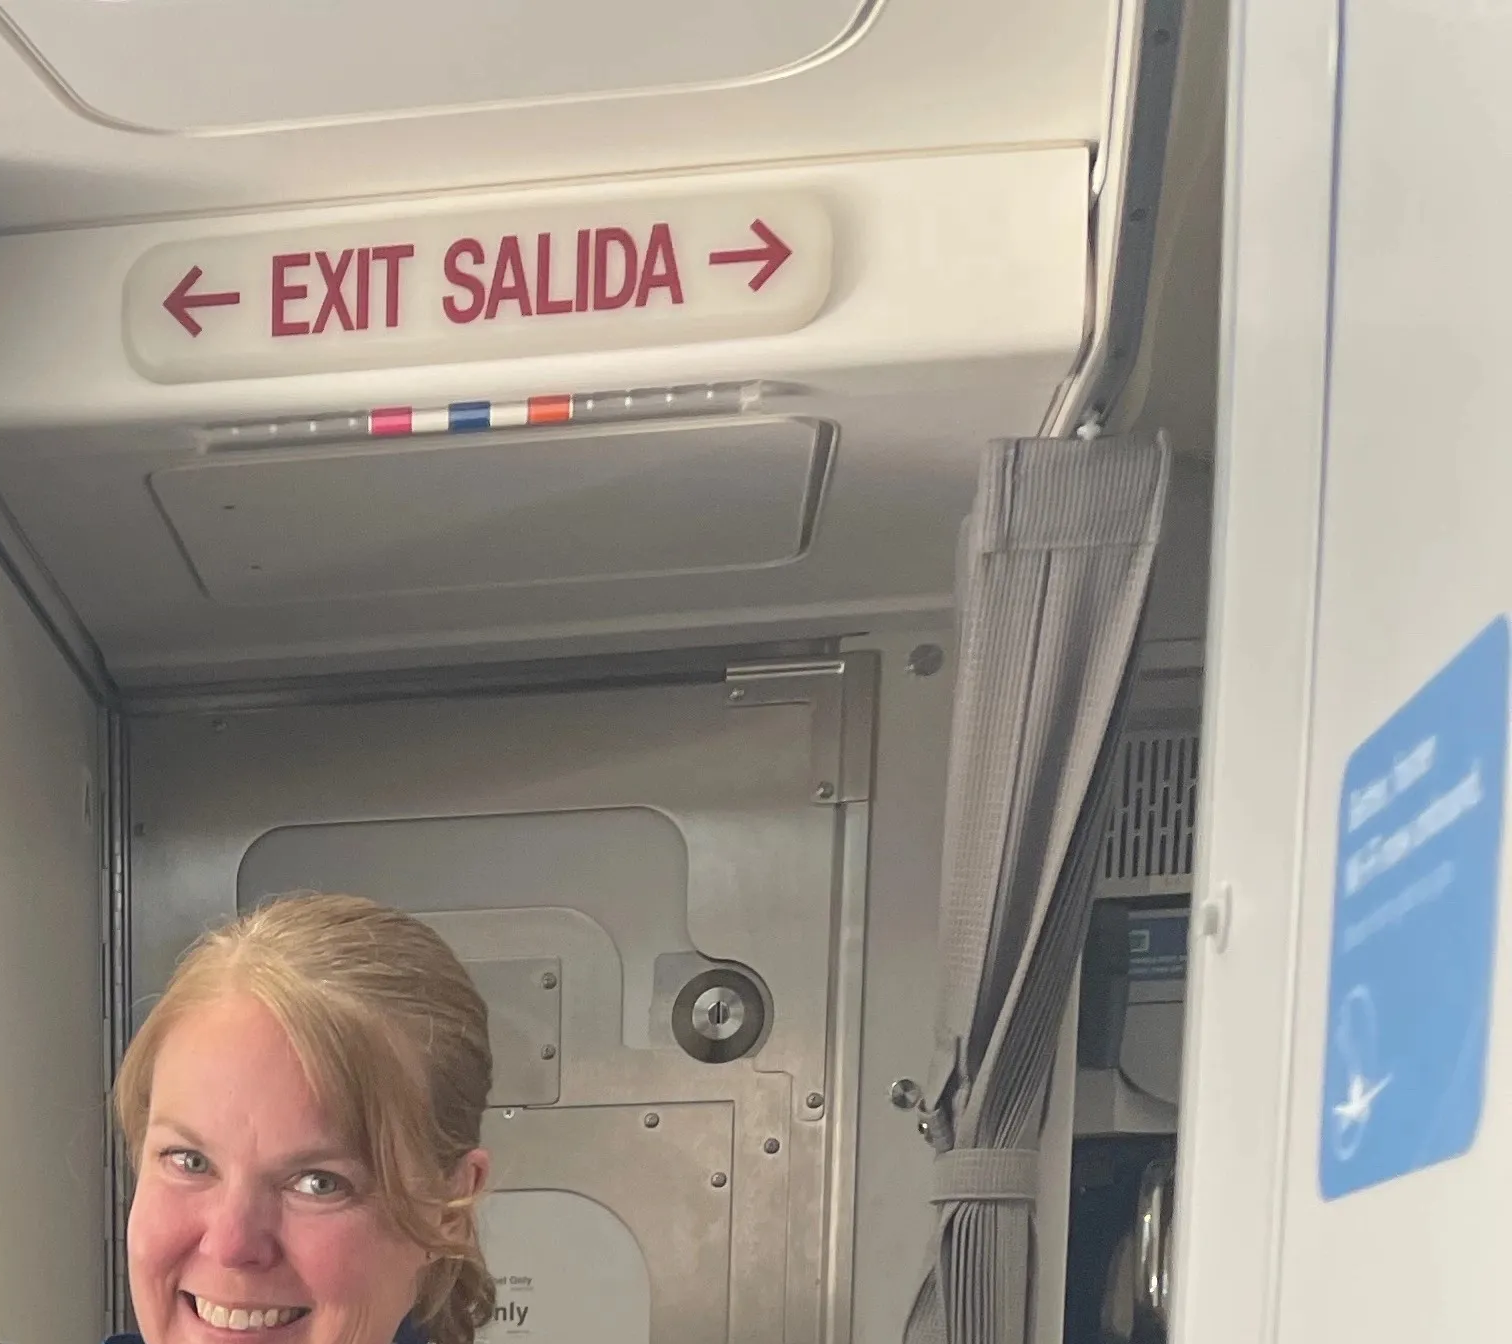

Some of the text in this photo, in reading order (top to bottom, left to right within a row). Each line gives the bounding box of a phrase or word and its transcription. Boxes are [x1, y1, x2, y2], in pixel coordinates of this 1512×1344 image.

[270, 222, 684, 338] EXIT SALIDA
[494, 1302, 529, 1327] nly
